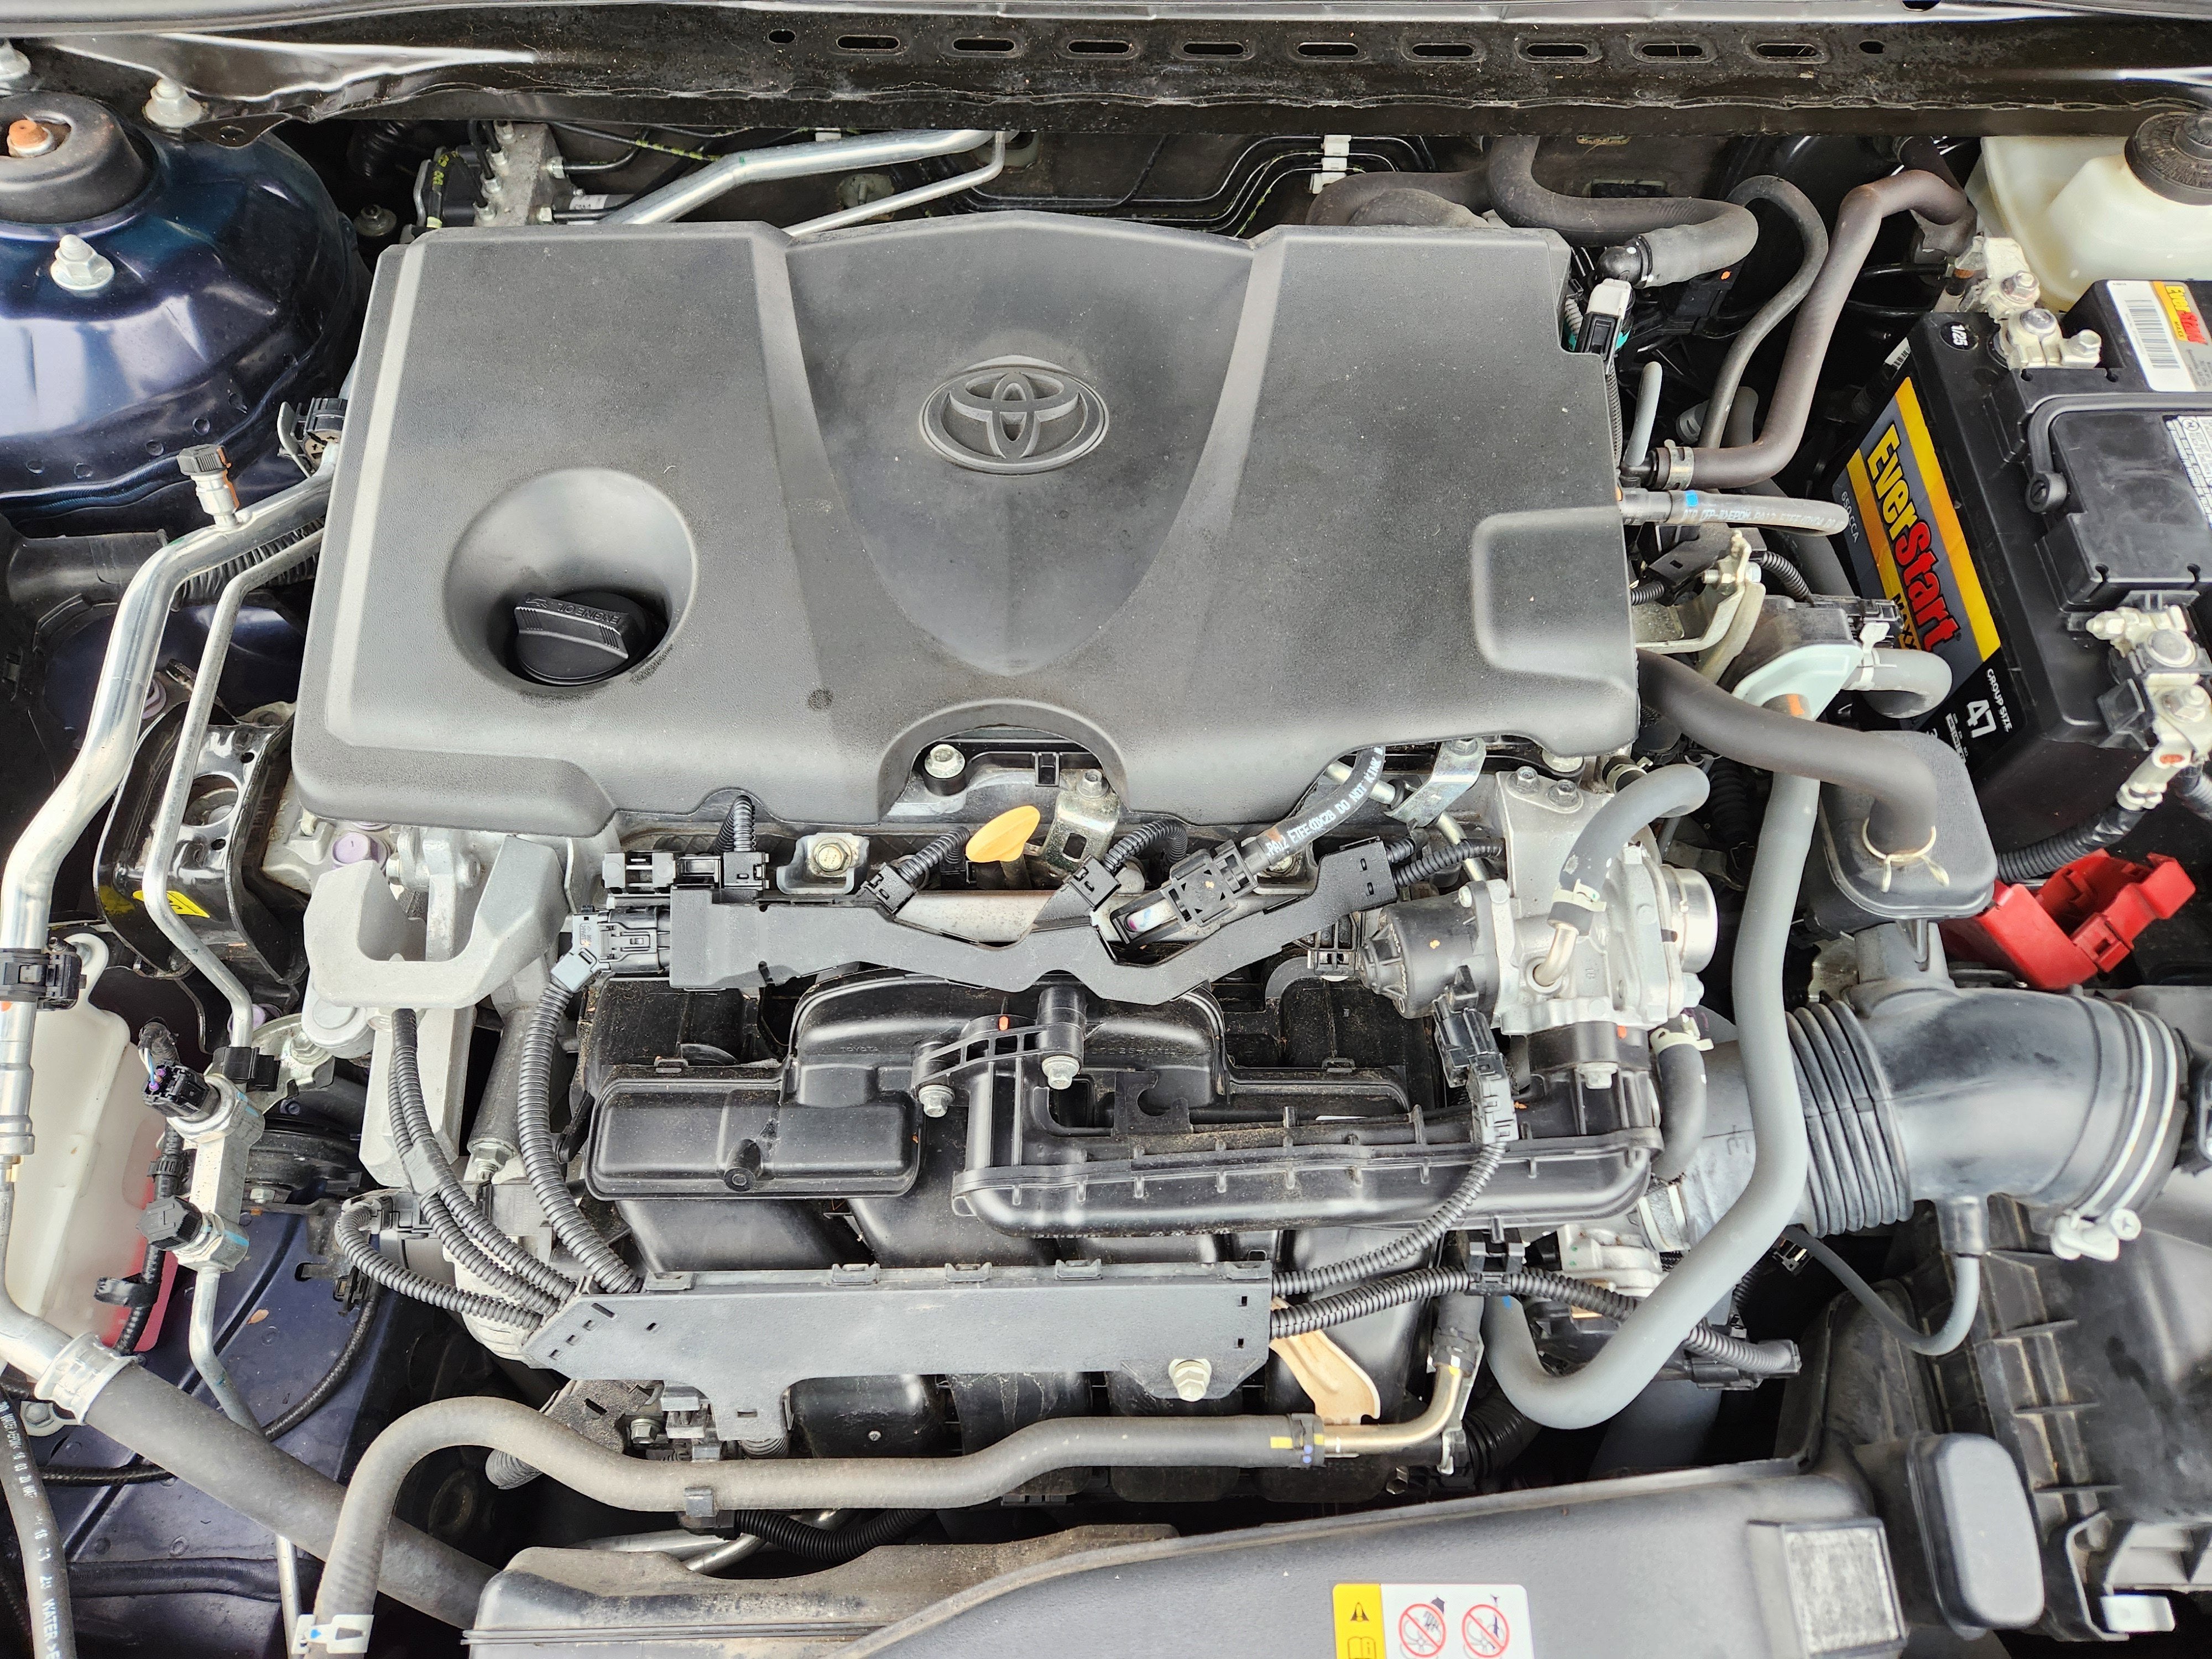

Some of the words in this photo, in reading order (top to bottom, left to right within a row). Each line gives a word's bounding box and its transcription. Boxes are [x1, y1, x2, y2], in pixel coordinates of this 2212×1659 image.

[1950, 324, 1969, 346] 1/25
[1841, 491, 1853, 515] 650
[1849, 515, 1859, 544] CCA
[1867, 422, 1961, 651] EverStart
[557, 602, 576, 614] OIL
[575, 607, 622, 625] ENGINE
[1966, 700, 1997, 739] 47
[1986, 668, 2004, 706] GROUP
[1998, 706, 2013, 733] SIZE
[1334, 799, 1351, 815] DO
[1348, 782, 1367, 803] NOT
[1363, 756, 1381, 784] KINK
